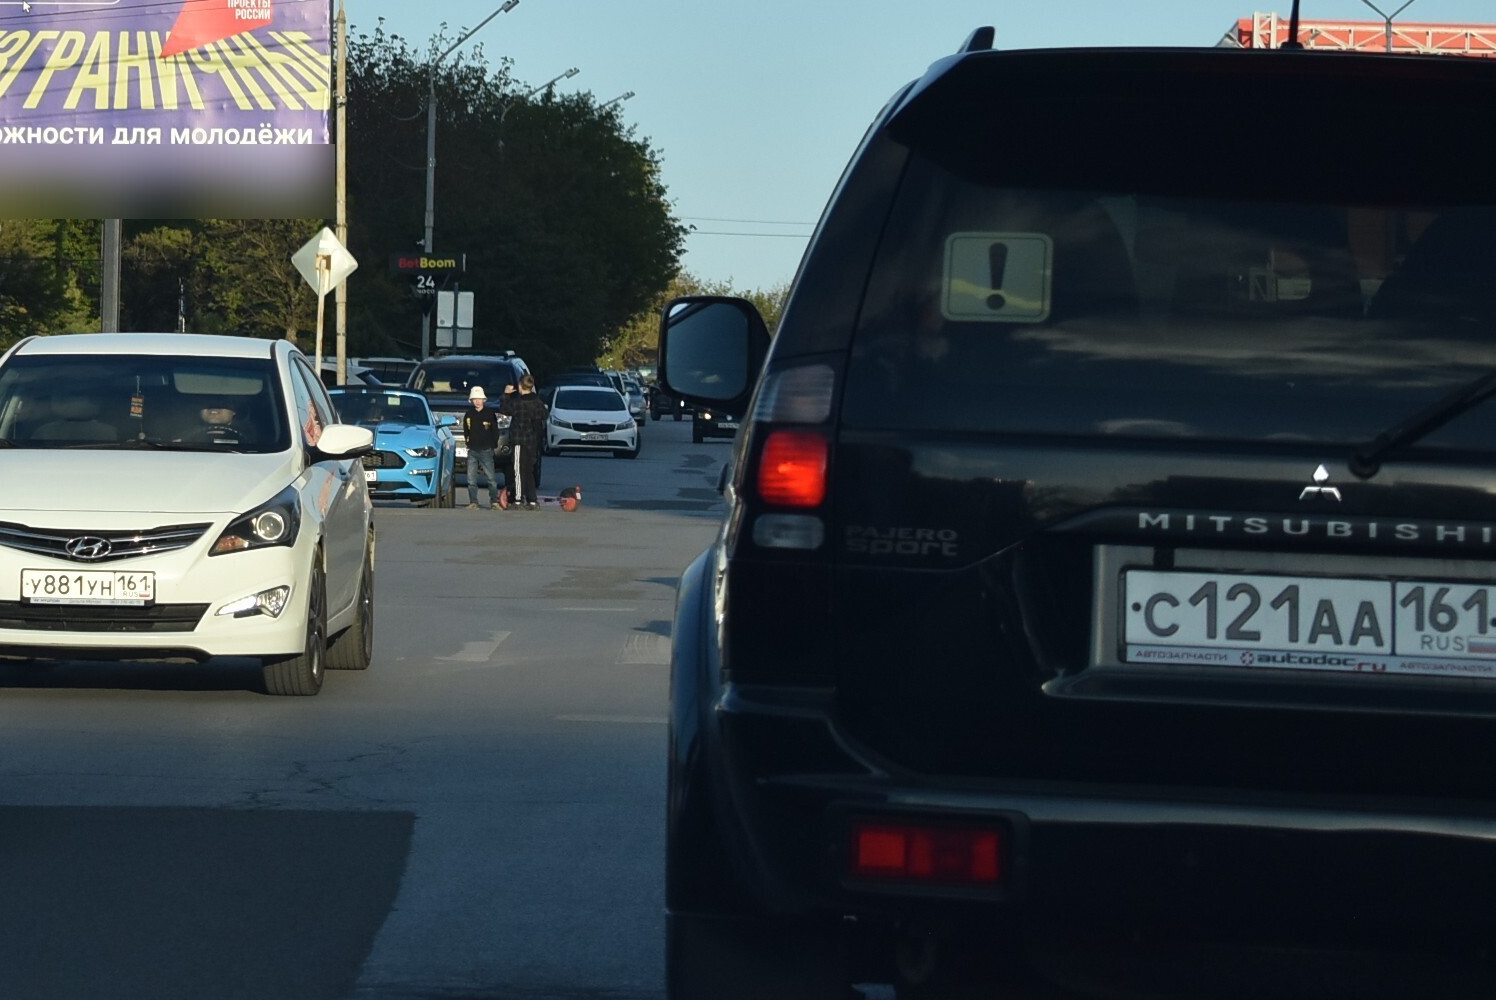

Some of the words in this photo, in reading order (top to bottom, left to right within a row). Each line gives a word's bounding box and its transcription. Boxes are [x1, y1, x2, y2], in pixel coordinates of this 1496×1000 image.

[235, 9, 271, 20] РОССИИ
[398, 257, 456, 268] BetBoom
[417, 275, 435, 288] 24
[1138, 512, 1492, 544] MITSUBISHI
[117, 575, 148, 591] 161
[1400, 586, 1488, 635] 161
[1421, 635, 1465, 651] RUS
